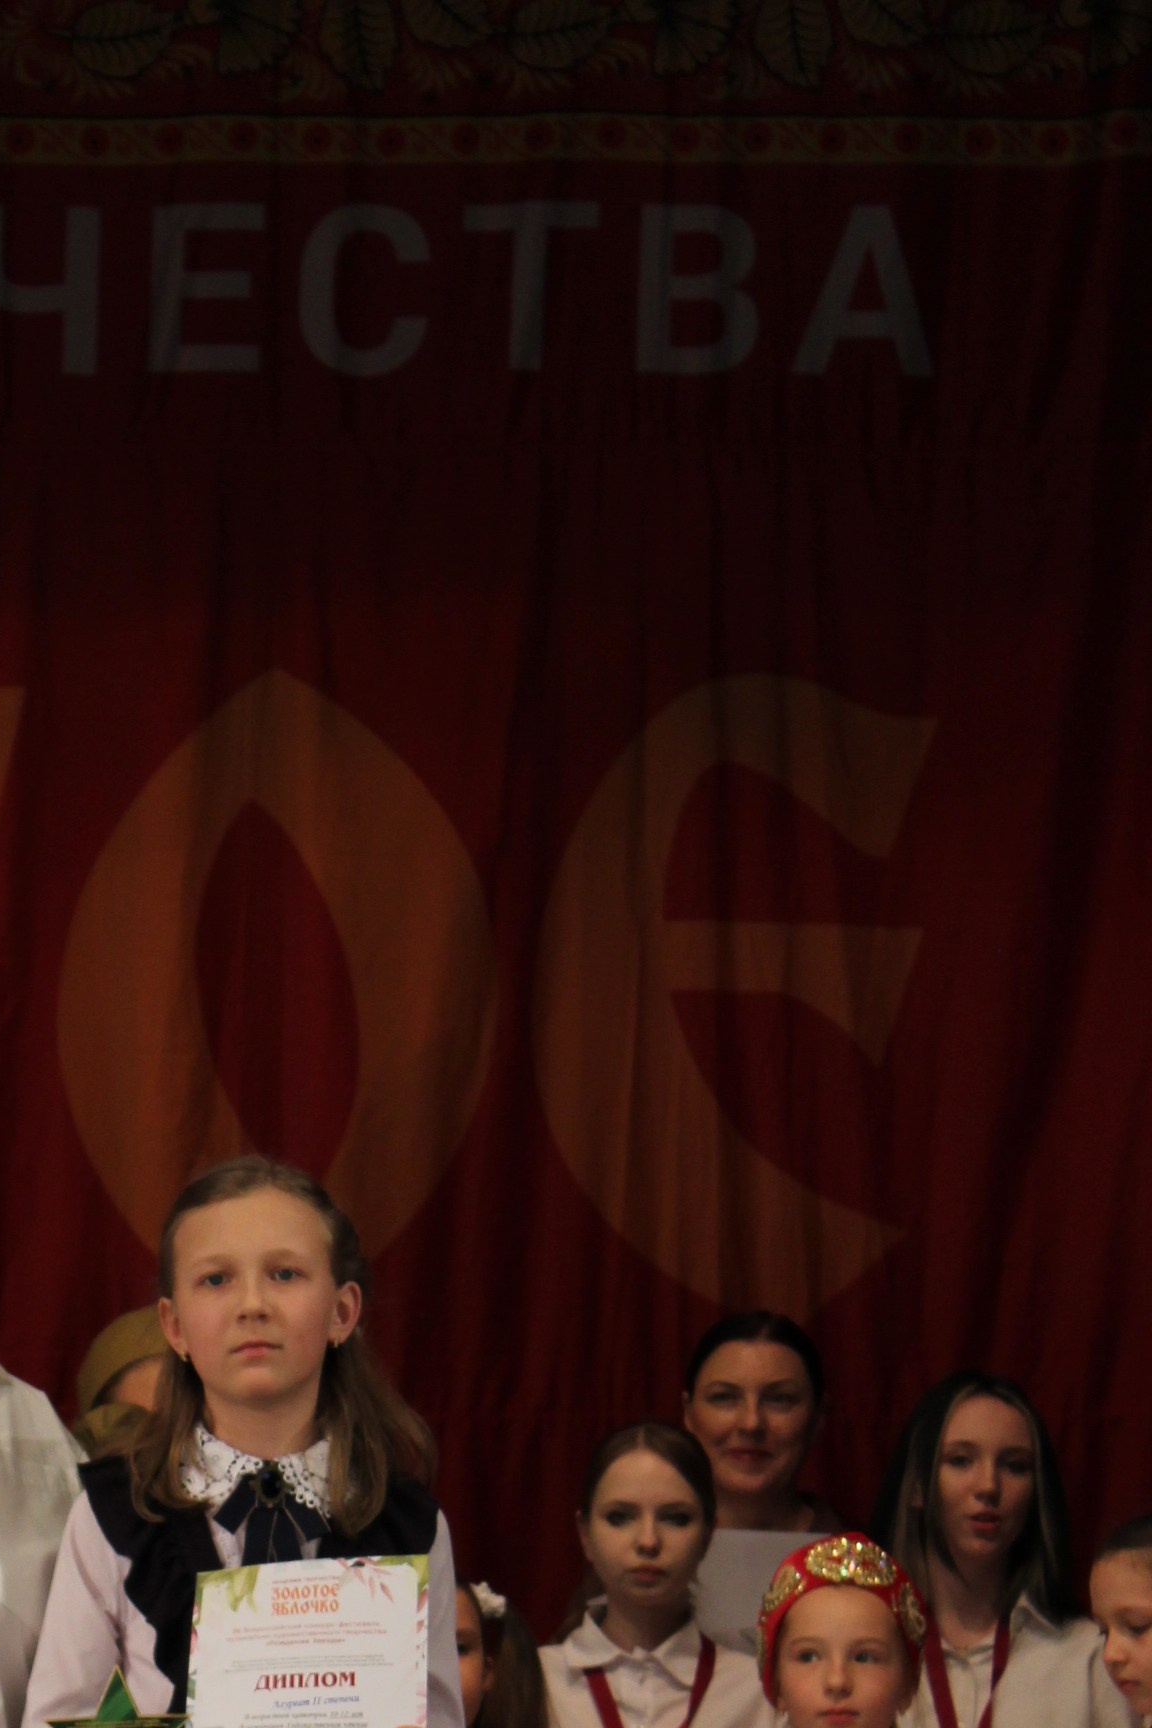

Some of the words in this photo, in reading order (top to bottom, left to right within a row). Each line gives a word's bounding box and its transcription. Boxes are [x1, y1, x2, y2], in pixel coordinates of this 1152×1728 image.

[272, 1583, 340, 1600] ЗОЛОТОЕ
[272, 1599, 340, 1616] ЯБЛОЧКО
[254, 1671, 356, 1692] ДИПЛОМ
